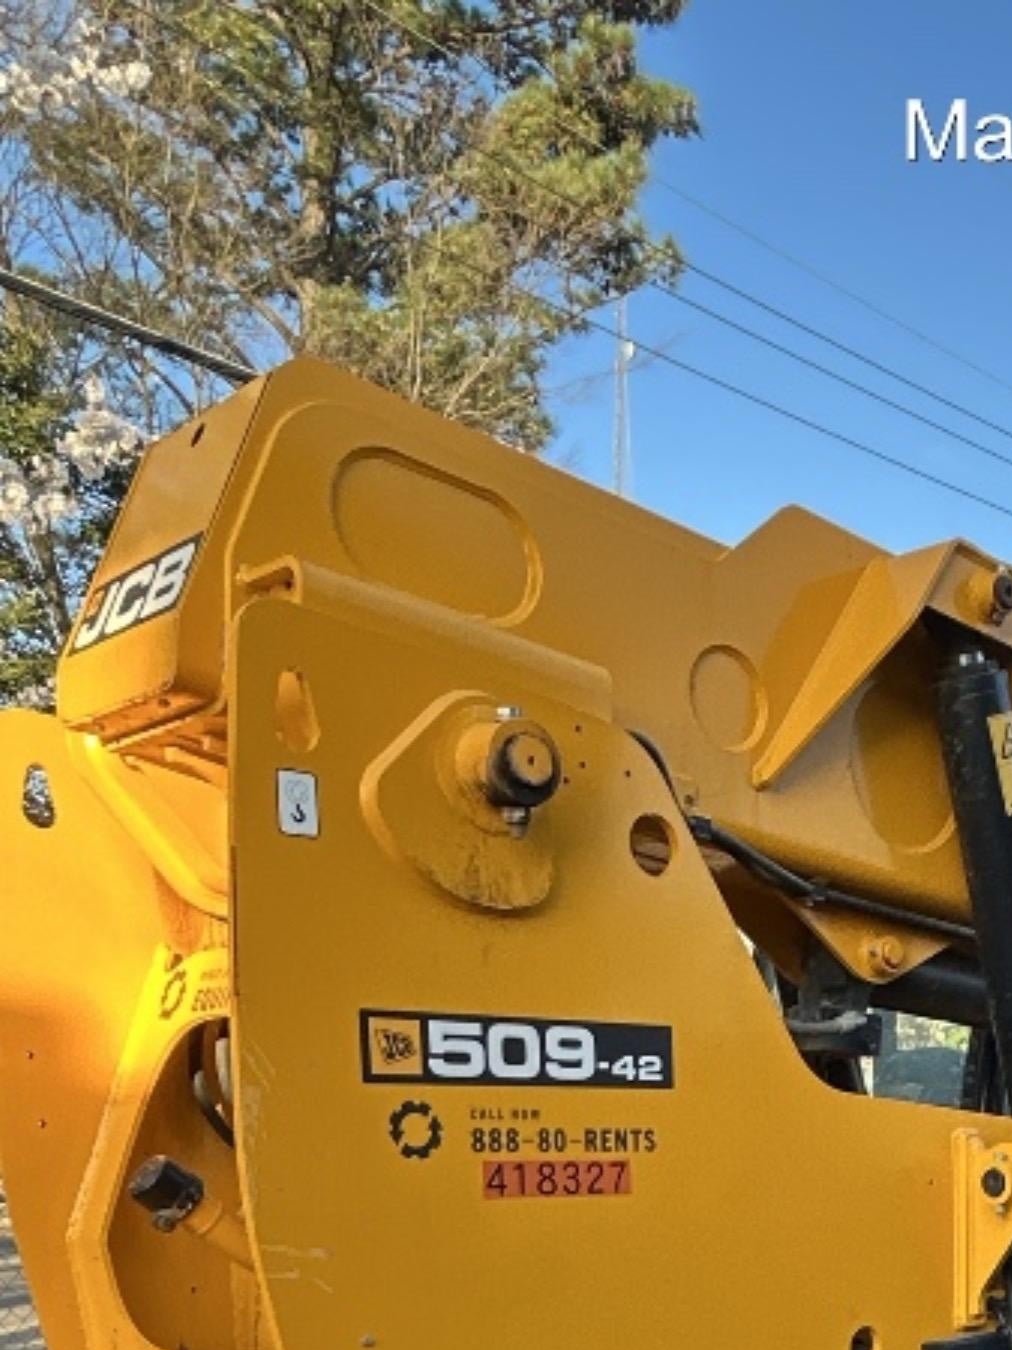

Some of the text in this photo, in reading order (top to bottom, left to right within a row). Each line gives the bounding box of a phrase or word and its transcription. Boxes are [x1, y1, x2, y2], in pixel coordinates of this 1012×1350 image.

[74, 541, 196, 650] JCB
[427, 1018, 665, 1082] 509-42
[470, 1127, 657, 1154] 888-80-RENTS
[486, 1160, 628, 1197] 418327
